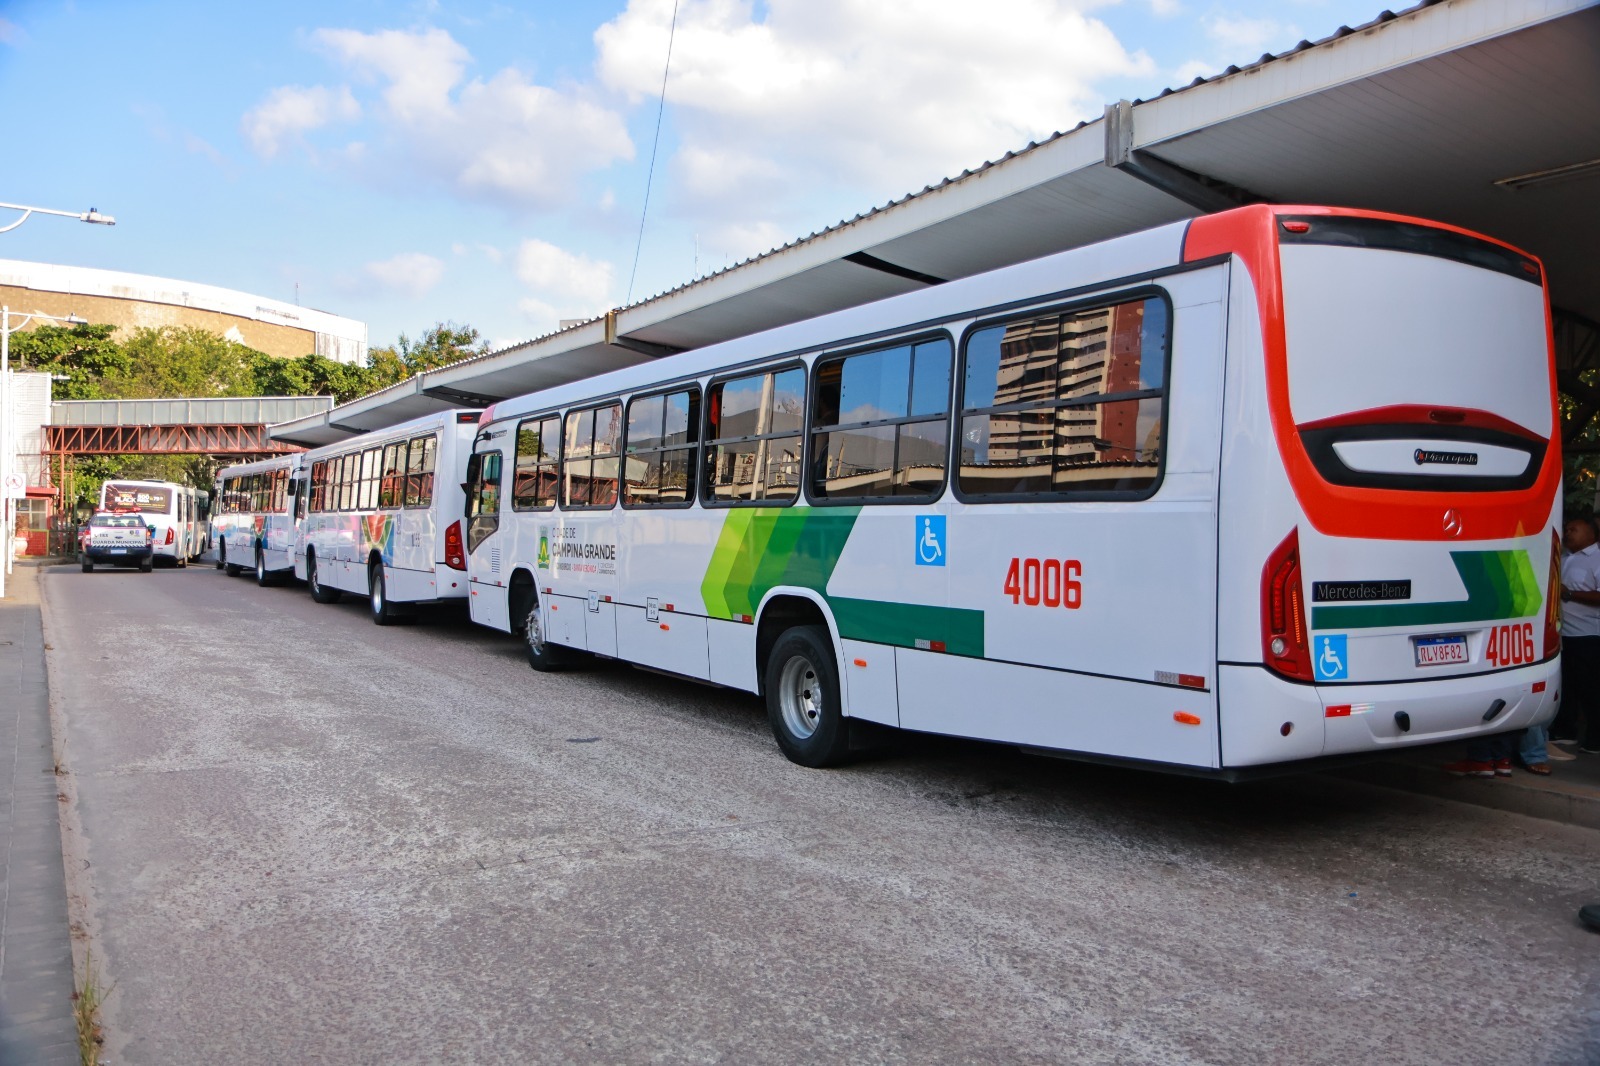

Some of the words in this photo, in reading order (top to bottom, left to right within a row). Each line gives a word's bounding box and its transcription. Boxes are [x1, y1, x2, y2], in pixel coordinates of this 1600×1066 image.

[569, 527, 577, 539] DE
[552, 542, 584, 559] CAMPINA
[584, 543, 616, 560] GRANDE
[1003, 557, 1082, 610] 4006
[1317, 582, 1407, 600] Mercedes-Benz
[1420, 644, 1462, 662] RLY8F82
[1485, 623, 1534, 667] 4006
